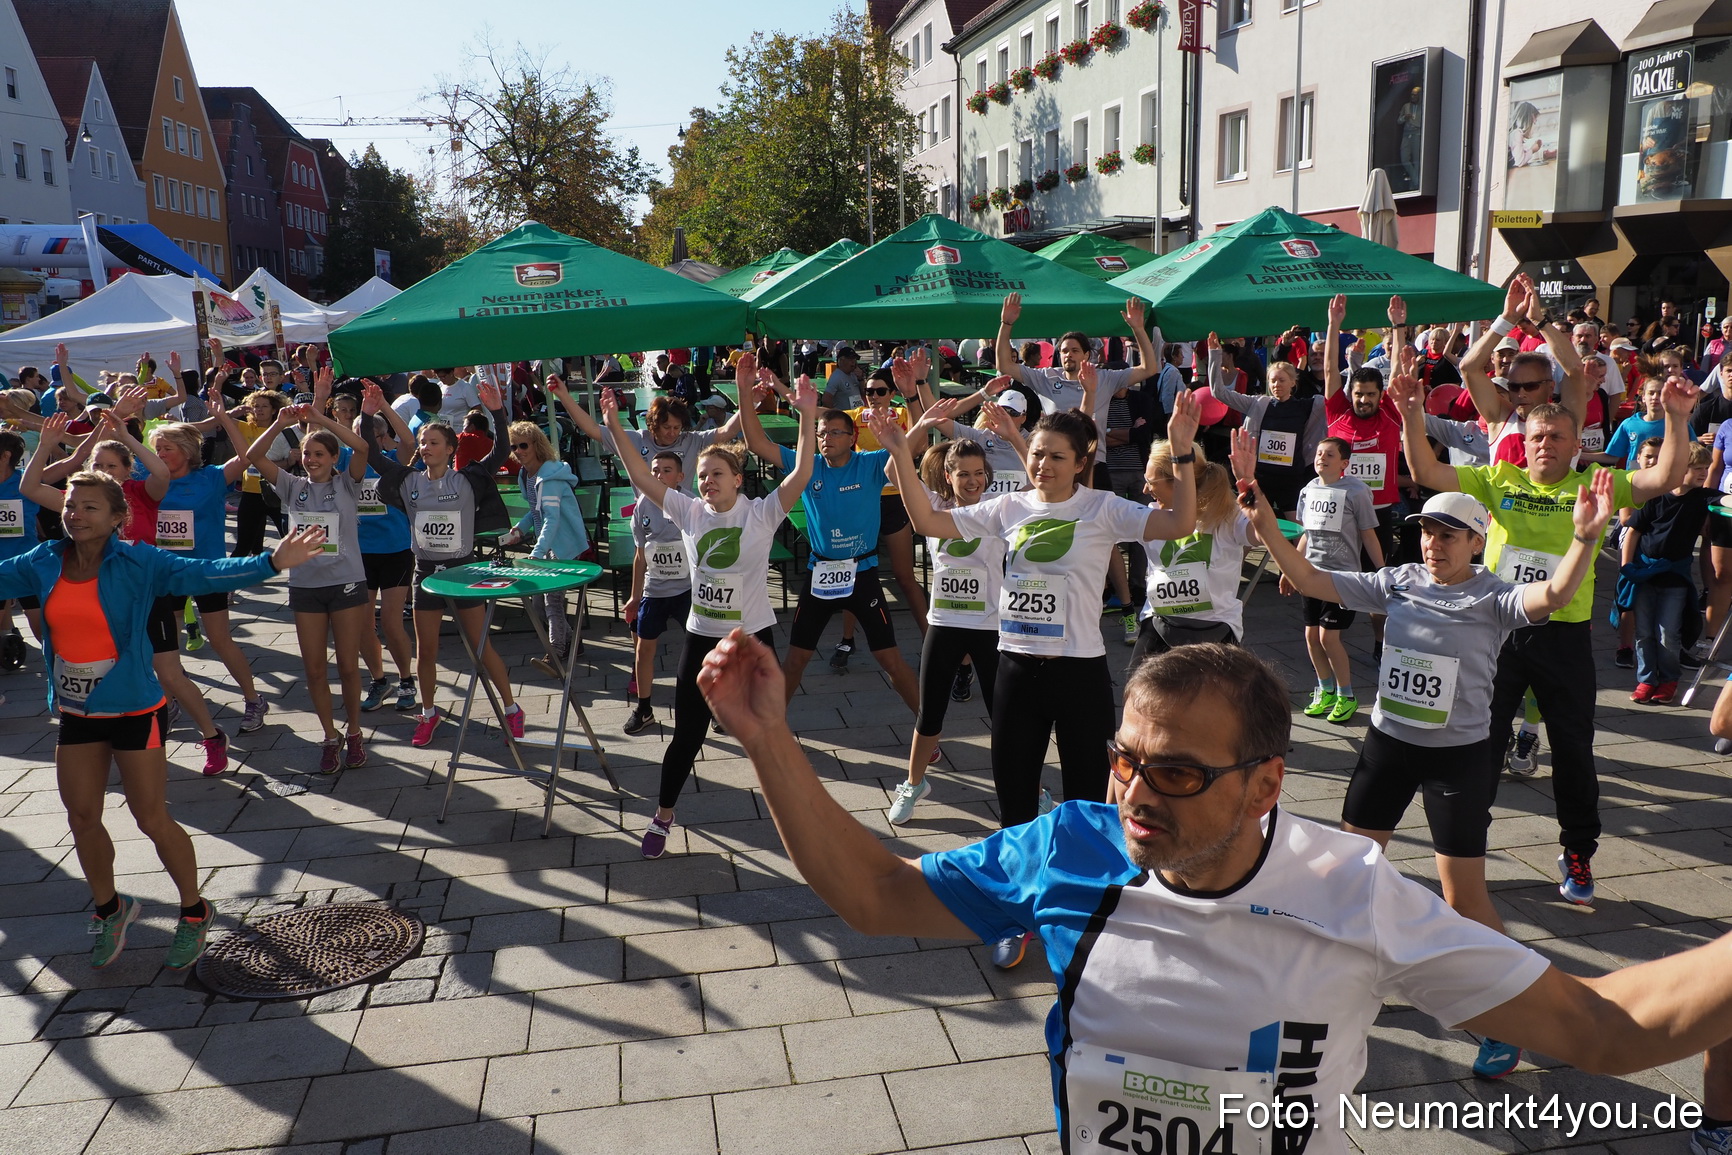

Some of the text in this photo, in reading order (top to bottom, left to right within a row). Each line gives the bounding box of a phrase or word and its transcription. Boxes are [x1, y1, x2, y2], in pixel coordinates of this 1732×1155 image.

[1184, 0, 1196, 46] Achatz
[1638, 49, 1683, 71] 100 Jahre
[1633, 67, 1673, 97] RACKL
[1003, 208, 1030, 235] RENO
[1493, 215, 1535, 225] Toiletten
[138, 254, 161, 272] PARTL
[1261, 261, 1364, 273] Neumarkter
[895, 268, 1001, 284] Neumarkter
[1245, 269, 1394, 286] Lammsbräu
[874, 276, 1026, 297] Lammsbräu
[1540, 281, 1563, 294] RACKL
[481, 288, 604, 304] Neumarkter
[458, 297, 628, 319] Lammsbräu
[1267, 440, 1286, 451] 306
[1581, 437, 1601, 446] 5124
[1351, 464, 1380, 475] 5118
[839, 484, 861, 492] BOCK
[991, 480, 1020, 492] 3117
[438, 493, 460, 502] BOCK
[1310, 500, 1337, 514] 4003
[158, 521, 188, 534] 5038
[422, 522, 455, 536] 4022
[831, 528, 843, 537] 18.
[831, 535, 859, 543] Neumarkter
[652, 552, 682, 565] 4014
[1519, 552, 1547, 565] BOCK
[659, 569, 680, 577] Magnus
[819, 571, 852, 585] 2308
[941, 578, 979, 594] 5049
[1017, 580, 1047, 588] BOCK
[1156, 579, 1200, 600] 5048
[698, 583, 734, 603] 5047
[1008, 591, 1056, 614] 2253
[1172, 605, 1195, 614] Isabel
[704, 609, 726, 619] Carolin
[1021, 624, 1039, 633] Nina
[1401, 655, 1433, 669] BOCK
[1388, 667, 1442, 698] 5193
[1390, 692, 1427, 705] PARTL Neumarkt
[1123, 1070, 1211, 1105] BOCK
[1122, 1090, 1211, 1112] inspired by smart concepts
[1098, 1100, 1238, 1155] 2504
